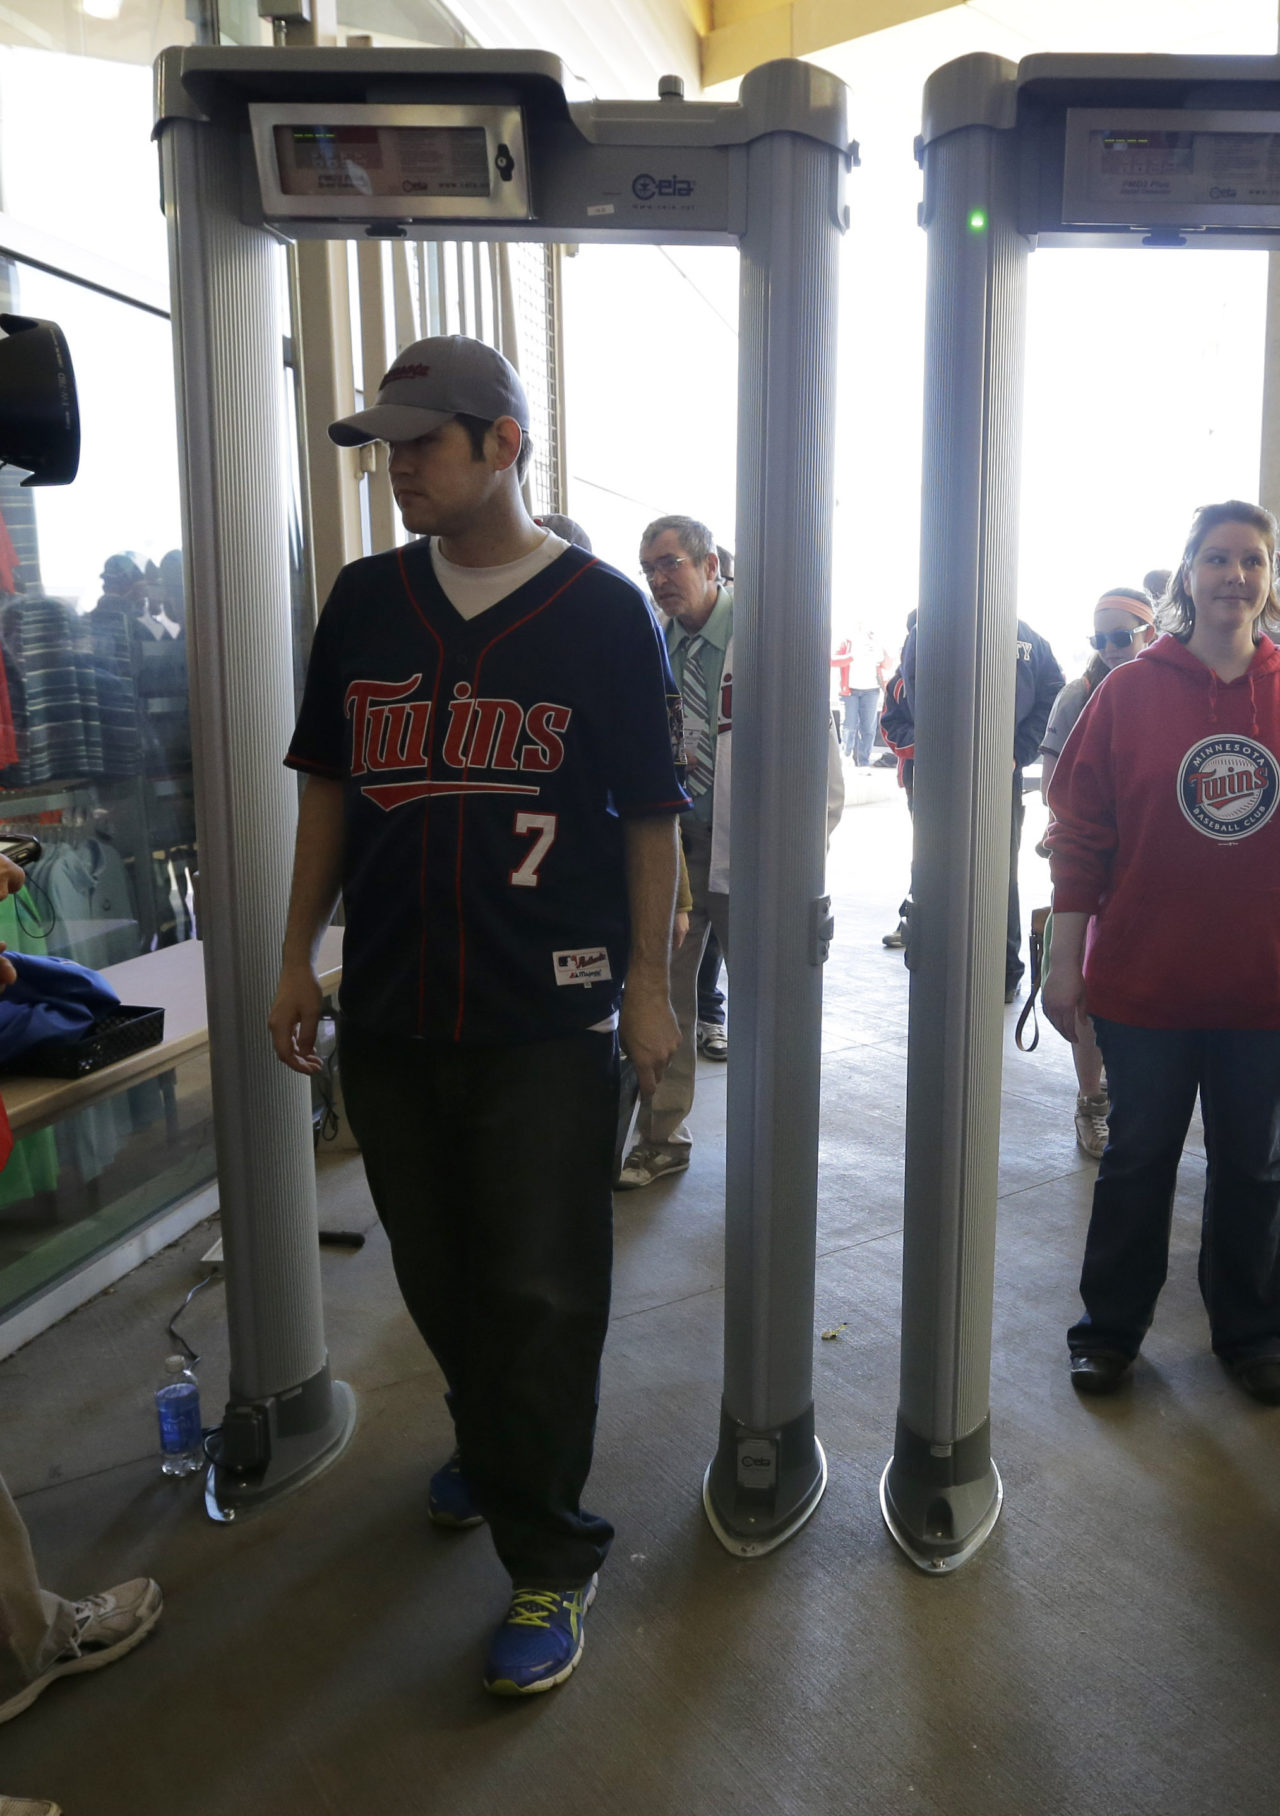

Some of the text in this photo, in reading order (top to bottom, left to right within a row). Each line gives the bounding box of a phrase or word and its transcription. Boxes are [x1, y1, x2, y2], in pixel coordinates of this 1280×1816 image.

[345, 673, 572, 777] Twins
[1193, 743, 1265, 768] MINNESOTA
[1188, 766, 1269, 805] Twins
[1193, 805, 1266, 831] BASEBALL CLUB
[508, 809, 558, 888] 7
